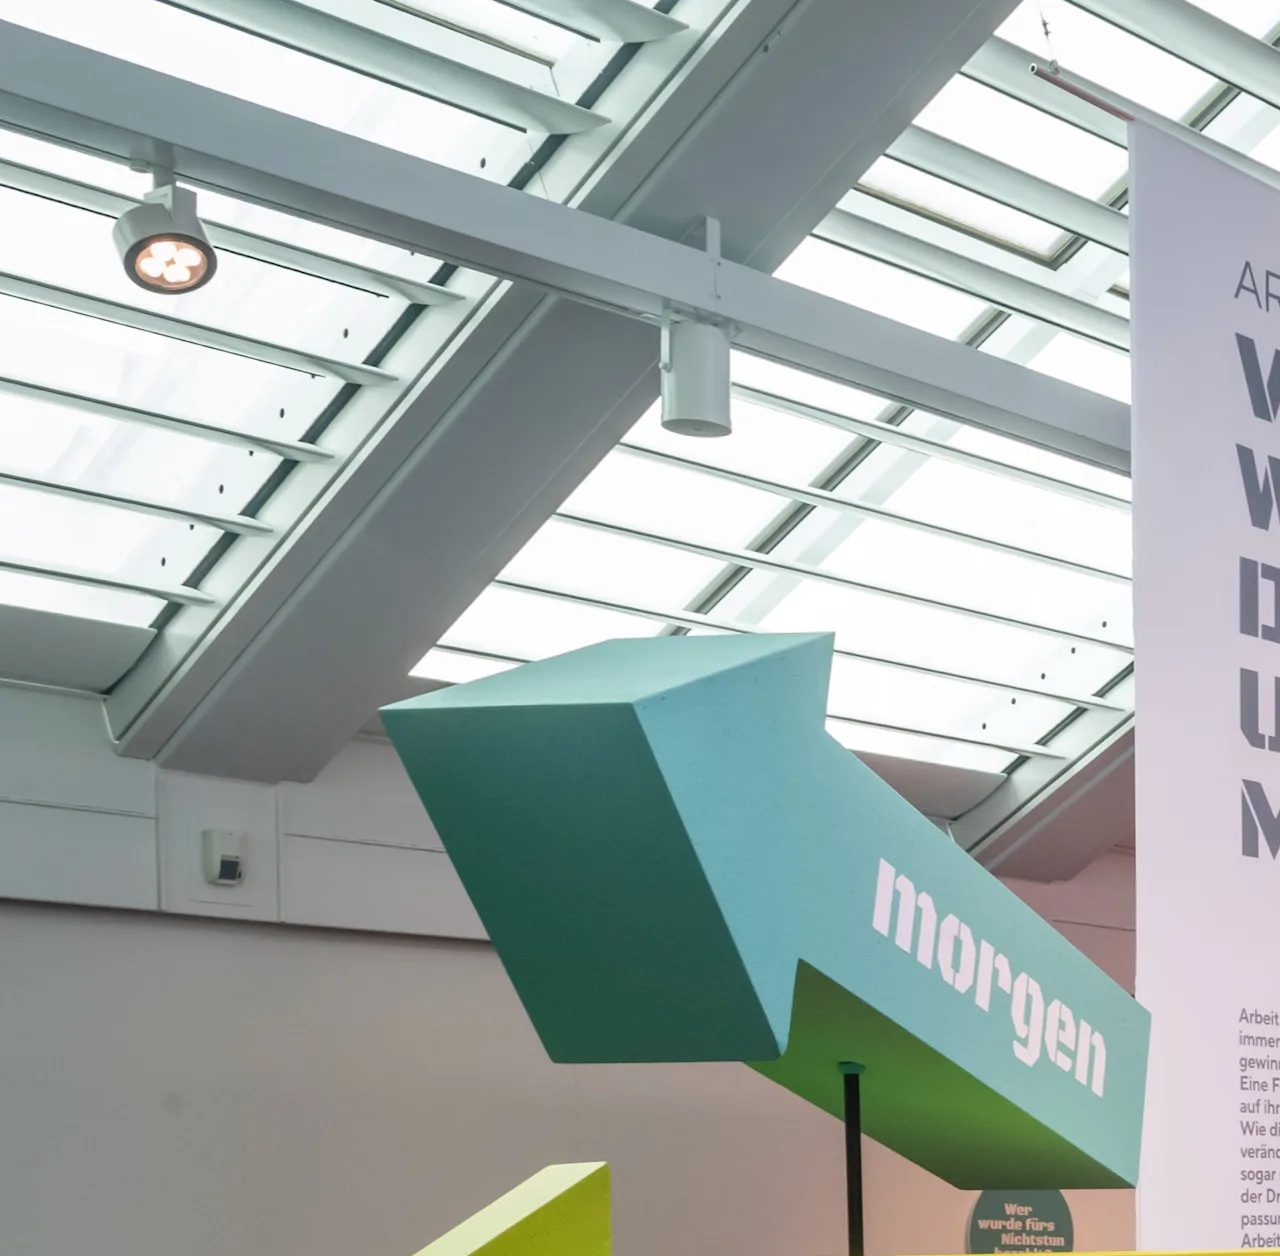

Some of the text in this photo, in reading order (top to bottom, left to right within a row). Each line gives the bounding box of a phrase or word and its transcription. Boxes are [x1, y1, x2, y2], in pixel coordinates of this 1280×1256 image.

[871, 858, 1107, 1098] morgen
[1239, 1008, 1279, 1026] Arbeit
[1240, 1031, 1280, 1048] immer
[1240, 1076, 1268, 1092] Eine
[1240, 1099, 1260, 1113] auf
[1264, 1100, 1280, 1114] ihr
[1240, 1121, 1266, 1136] Wie
[1241, 1170, 1276, 1185] sogar
[1004, 1203, 1032, 1216] Wer
[978, 1218, 1055, 1231] wurde fürs
[1001, 1233, 1064, 1246] Nichtstun
